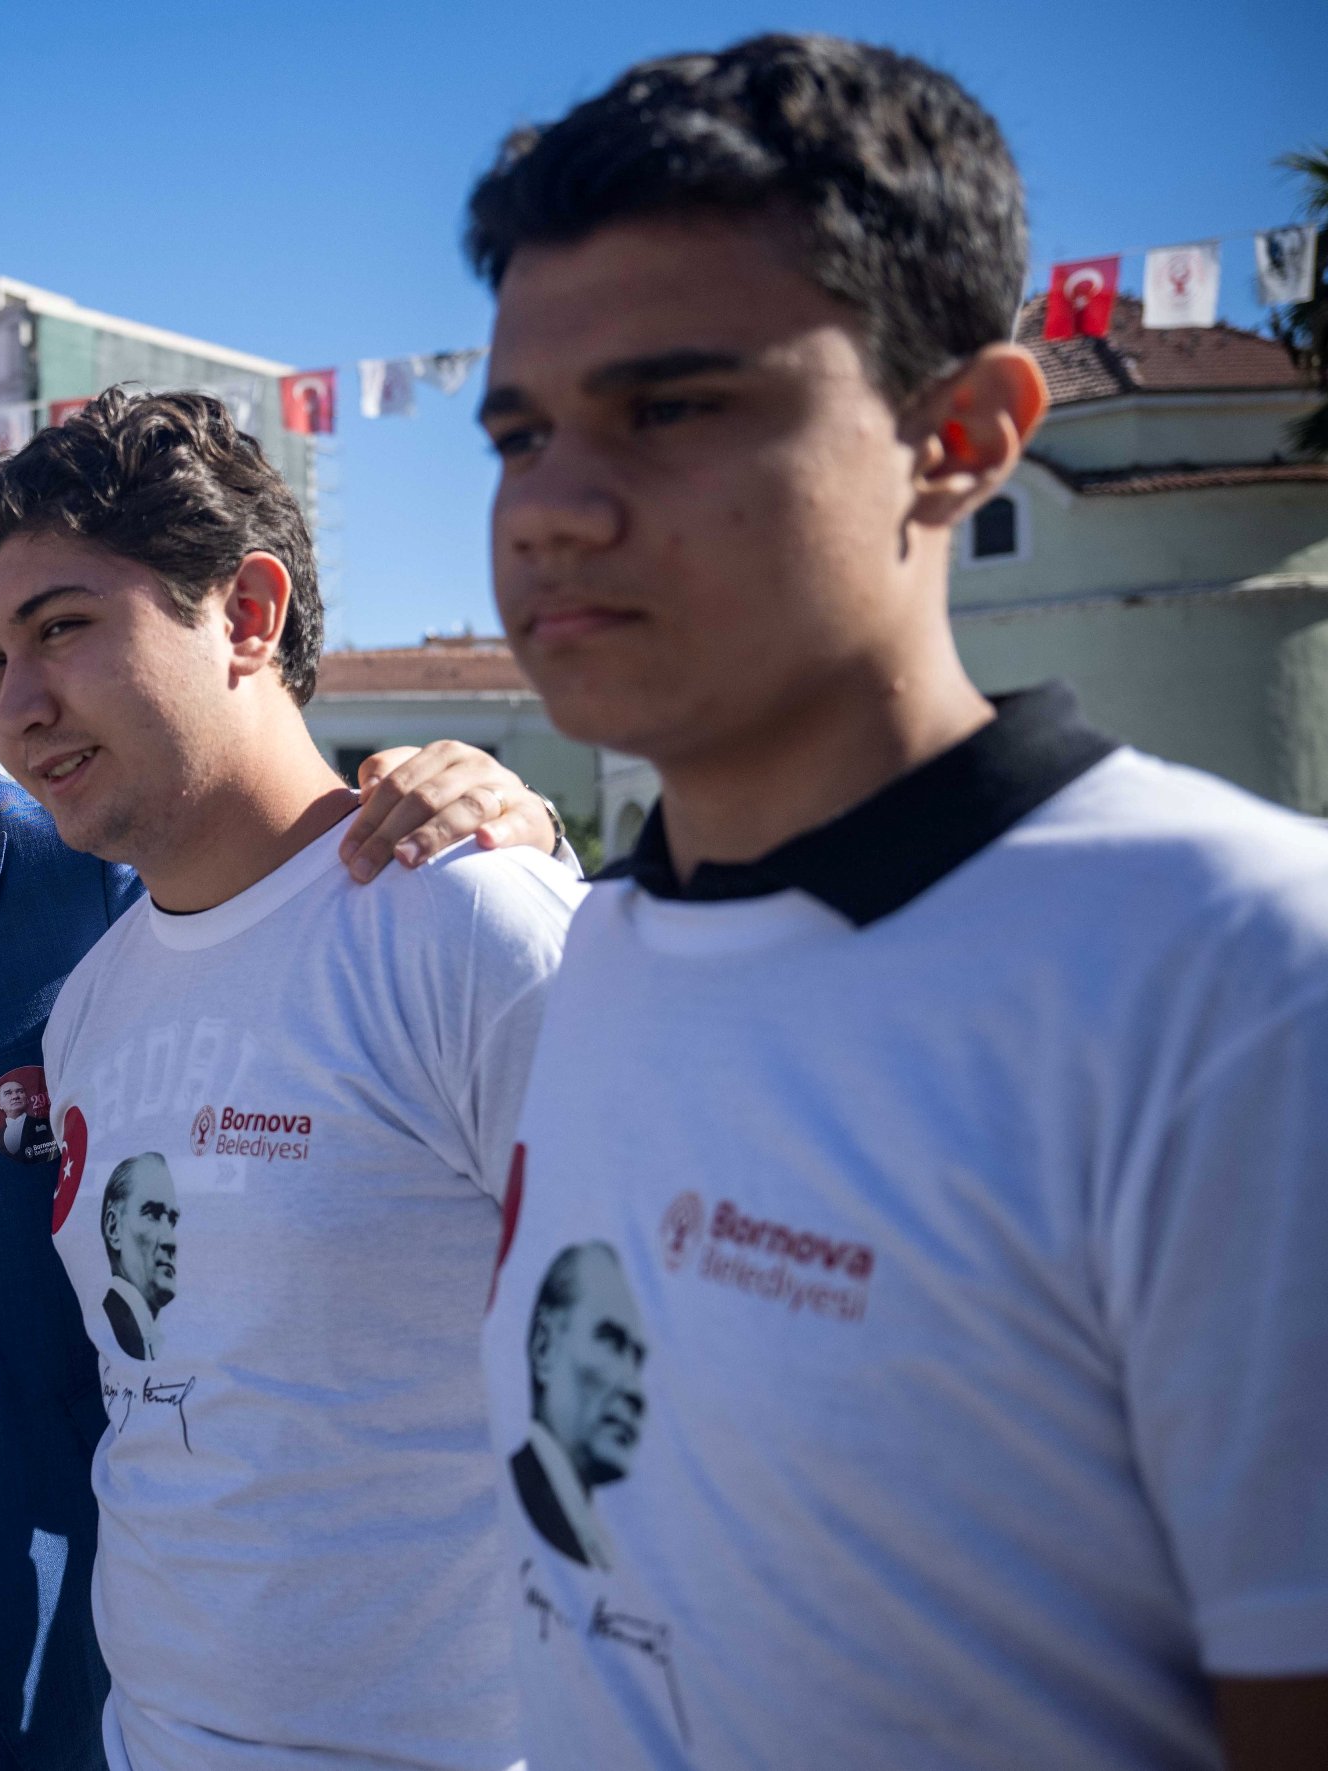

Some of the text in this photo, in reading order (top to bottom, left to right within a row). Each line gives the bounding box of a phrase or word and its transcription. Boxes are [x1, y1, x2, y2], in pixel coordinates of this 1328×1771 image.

[219, 1106, 312, 1135] Bornova
[215, 1133, 310, 1162] Belediyesi
[709, 1198, 875, 1281] Bornova
[698, 1245, 867, 1323] Belediyesi
